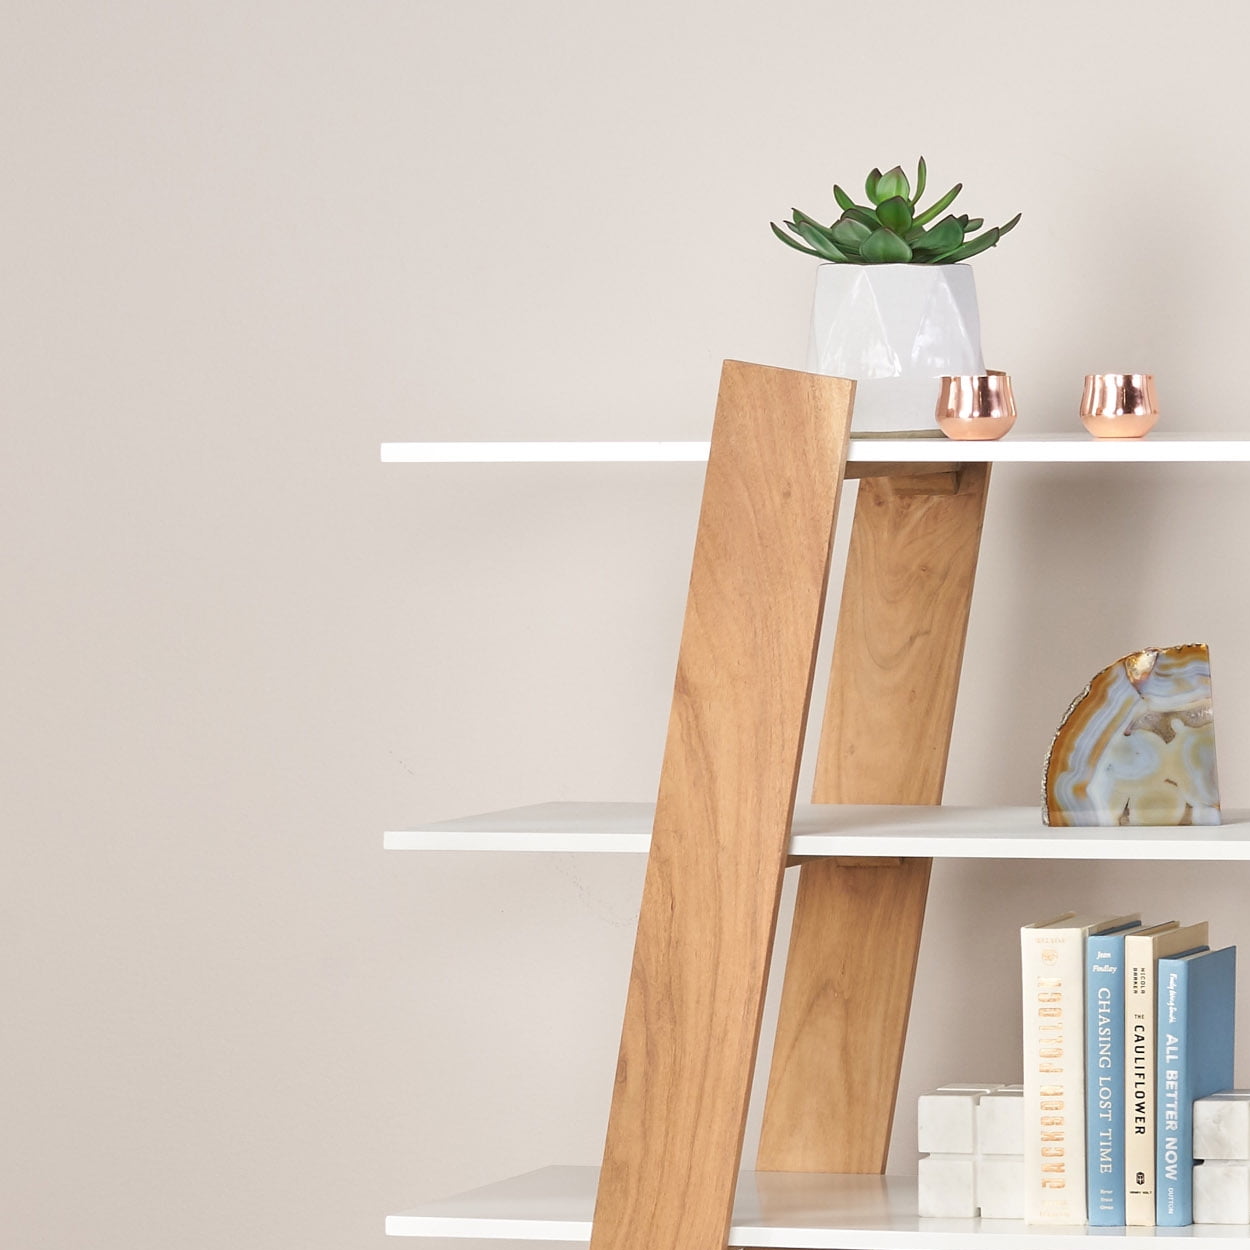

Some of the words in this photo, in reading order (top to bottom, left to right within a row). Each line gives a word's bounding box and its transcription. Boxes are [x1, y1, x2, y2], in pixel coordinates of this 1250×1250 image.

[1037, 975, 1064, 1073] POLLOCK
[1098, 987, 1112, 1069] CHASING
[1165, 1033, 1179, 1064] ALL
[1099, 1076, 1112, 1122] LOST
[1134, 1025, 1146, 1135] CAULIFLOWER
[1165, 1070, 1179, 1131] BETTER
[1040, 1085, 1066, 1189] JACKSON
[1099, 1128, 1113, 1174] TIME
[1165, 1137, 1179, 1181] NOW
